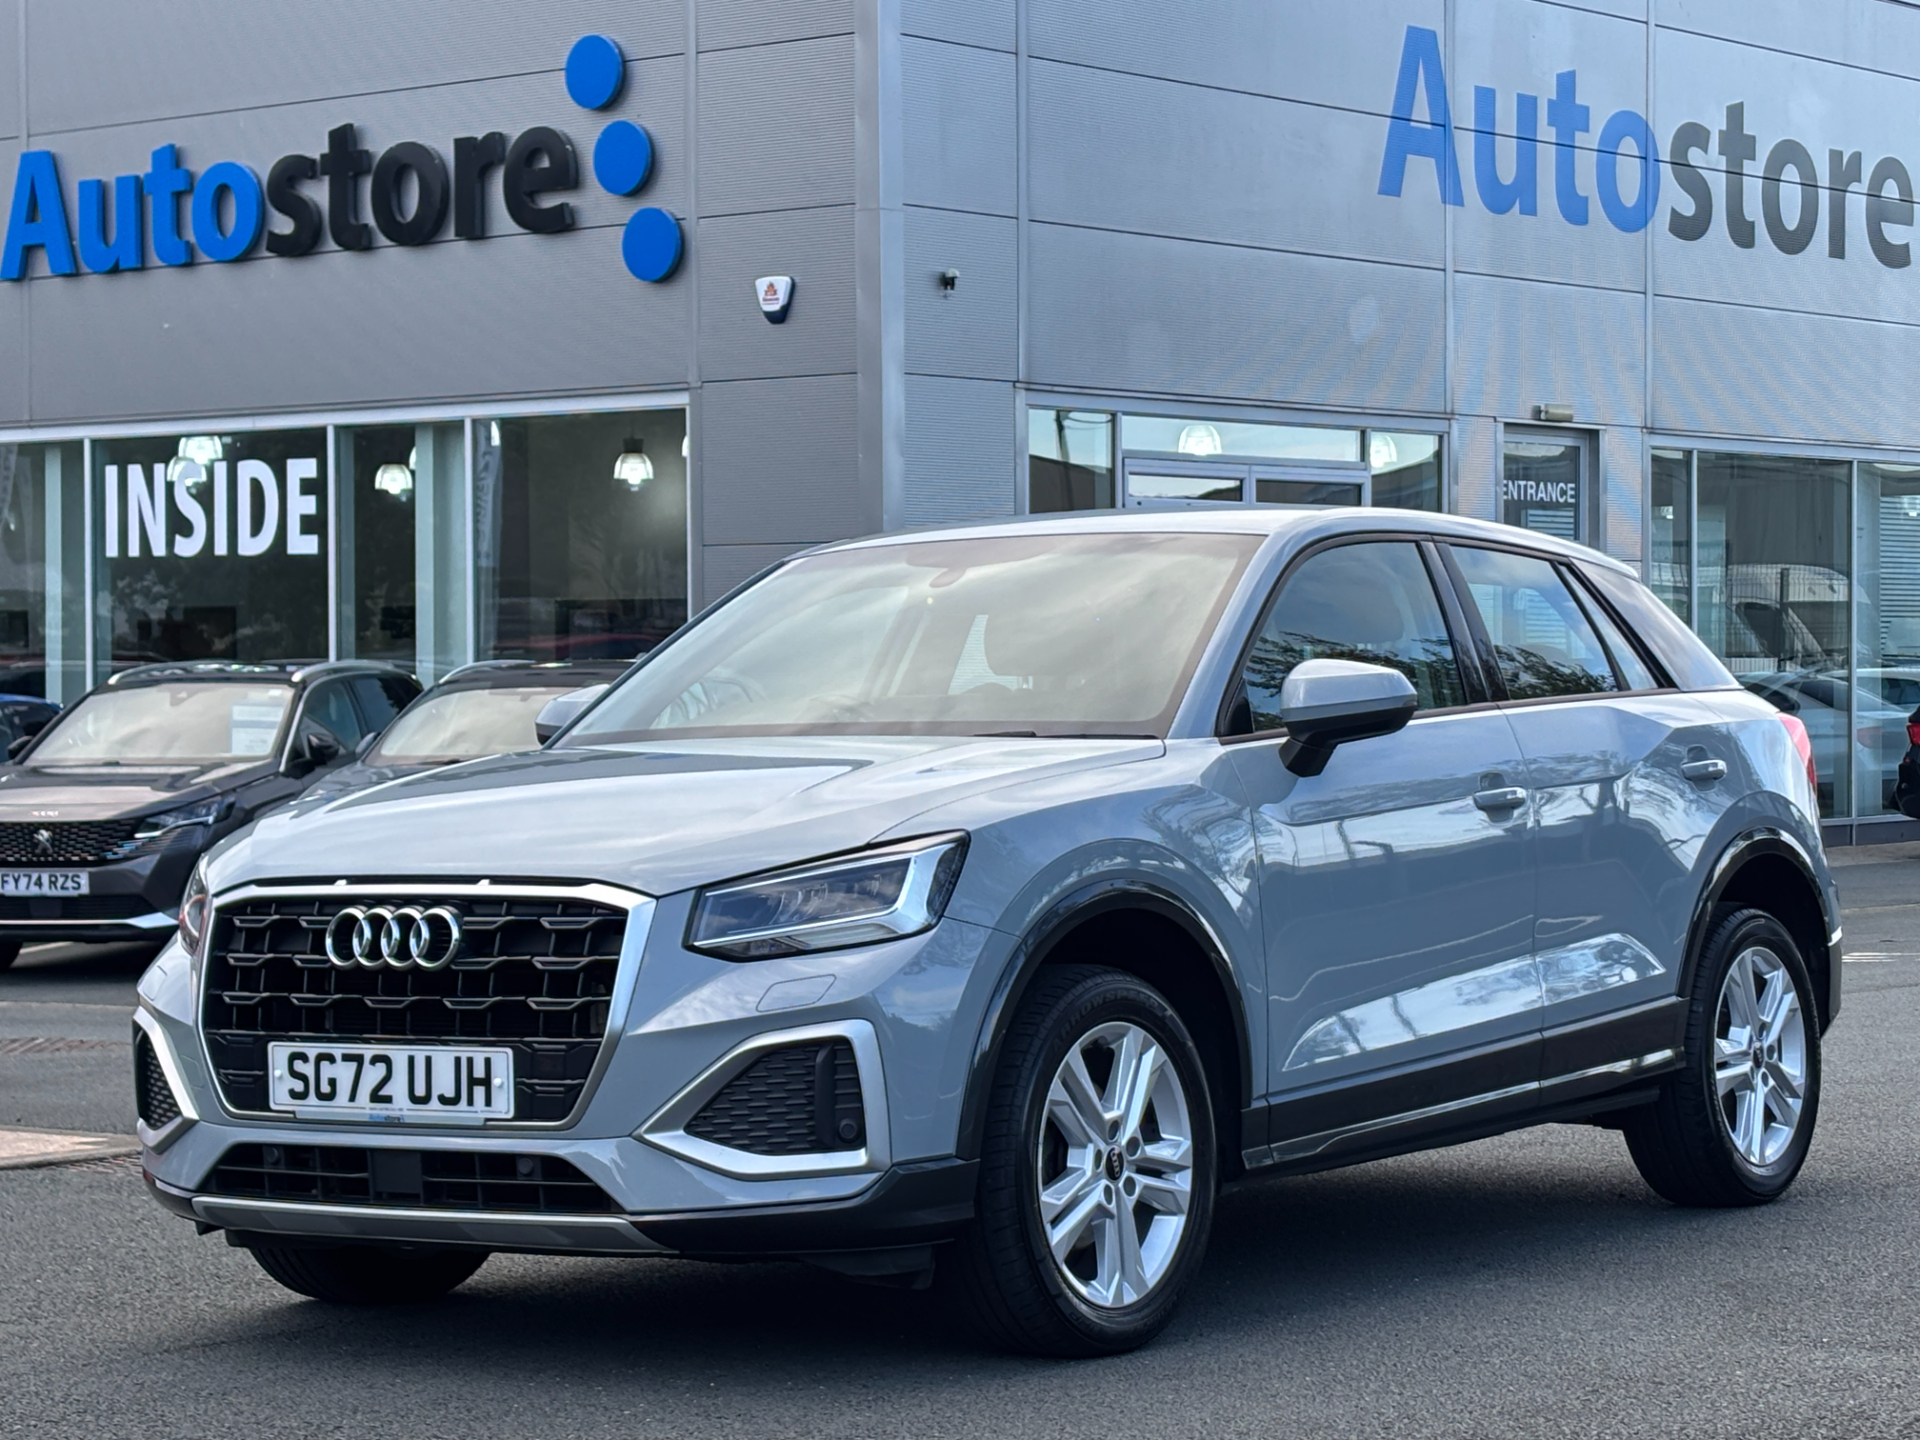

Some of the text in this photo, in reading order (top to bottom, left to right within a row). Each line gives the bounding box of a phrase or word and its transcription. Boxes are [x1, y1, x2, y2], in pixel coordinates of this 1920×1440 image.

[1377, 24, 1914, 269] Autostore
[1, 122, 579, 281] Autostore
[104, 457, 319, 559] INSIDE
[0, 873, 81, 891] FY74 RZS
[287, 1051, 492, 1107] SG72 UJH
